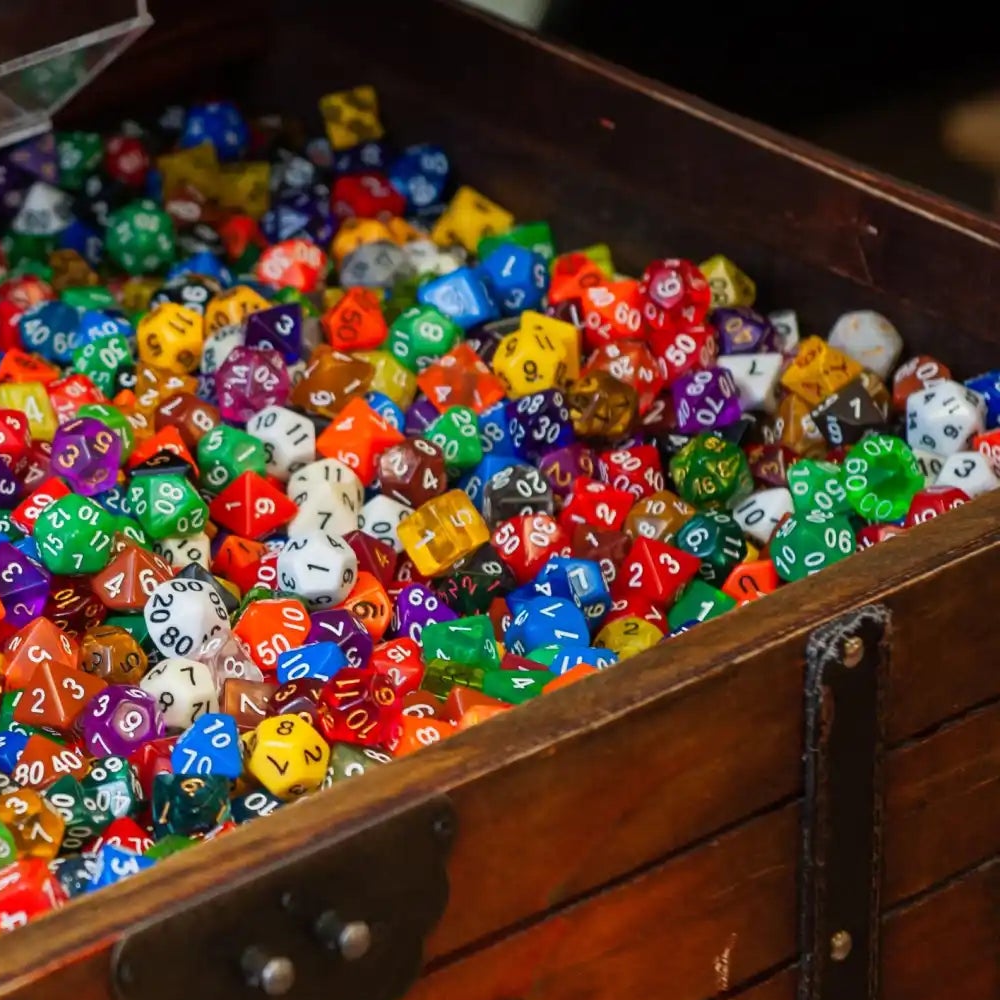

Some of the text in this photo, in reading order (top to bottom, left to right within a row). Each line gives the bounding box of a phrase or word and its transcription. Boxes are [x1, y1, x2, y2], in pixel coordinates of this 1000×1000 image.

[419, 322, 443, 342] 8
[25, 396, 43, 423] 4
[255, 413, 277, 433] 10
[532, 418, 560, 443] 30
[324, 466, 341, 481] 11
[955, 459, 975, 479] 3
[645, 501, 665, 514] 10
[739, 500, 764, 525] 10
[318, 512, 331, 529] 7
[660, 554, 680, 573] 3
[629, 563, 642, 587] 2
[150, 594, 173, 623] 20
[623, 623, 639, 635] 2
[160, 627, 193, 656] 80
[257, 634, 291, 665] 50
[63, 678, 84, 699] 3
[31, 689, 45, 713] 2
[204, 719, 231, 748] 10
[277, 721, 294, 735] 8
[52, 751, 82, 773] 40
[183, 748, 212, 774] 70
[267, 756, 289, 775] 7
[15, 761, 43, 785] 80
